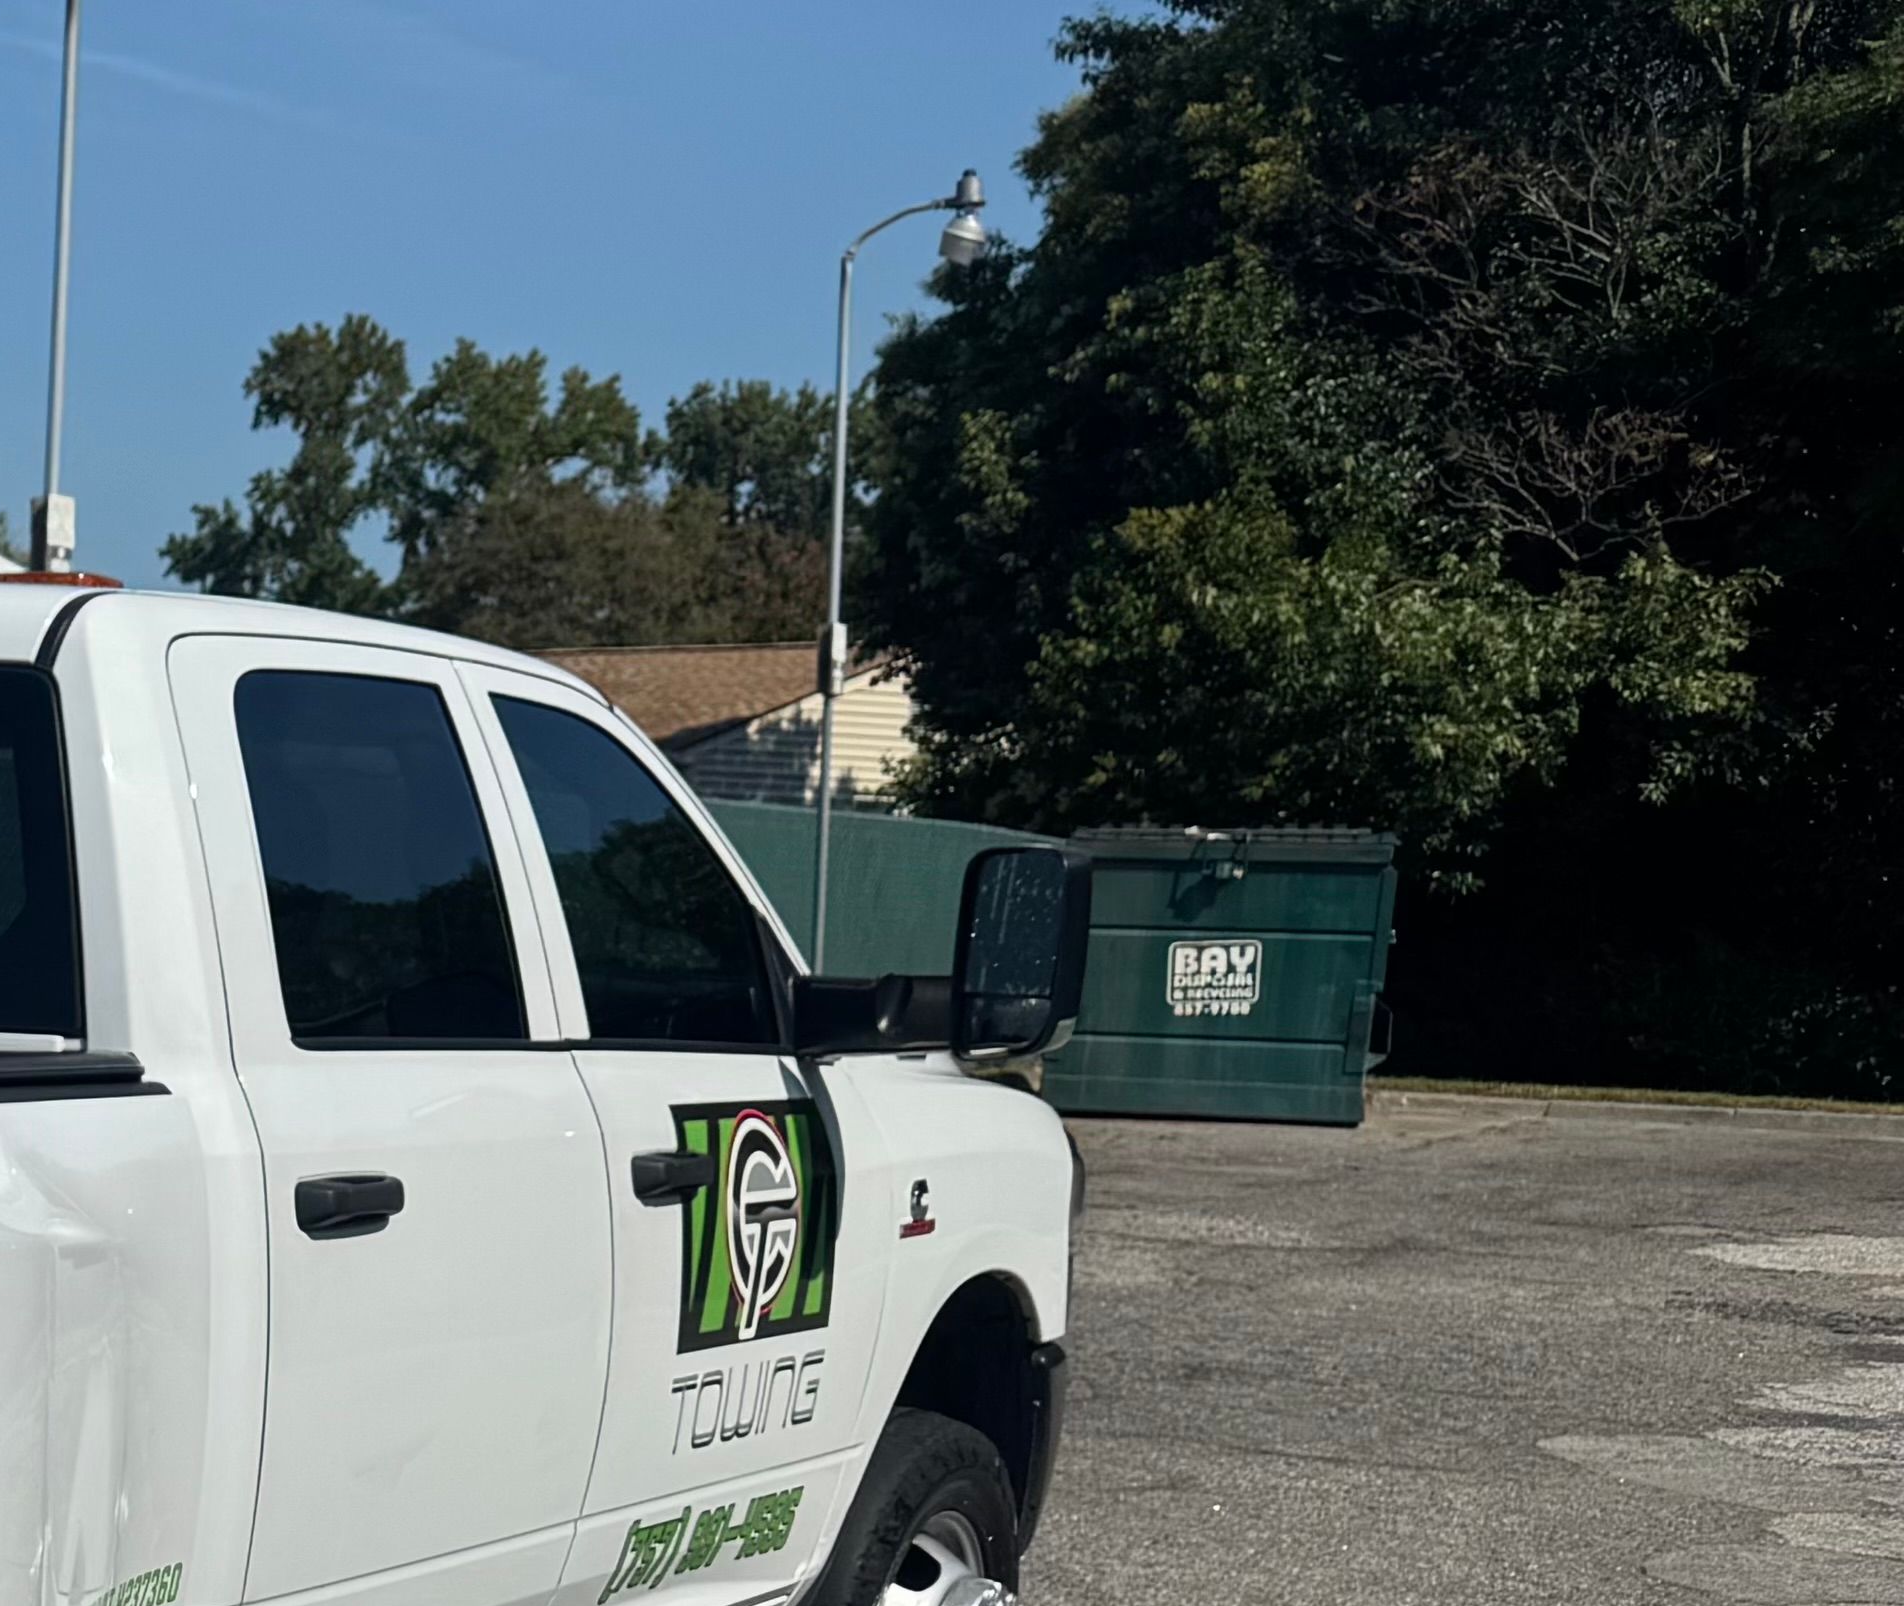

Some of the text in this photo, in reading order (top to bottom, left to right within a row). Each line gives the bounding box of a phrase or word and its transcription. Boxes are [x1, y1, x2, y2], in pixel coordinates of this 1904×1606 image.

[1174, 945, 1256, 975] BAY
[671, 1348, 826, 1455] TOWING
[674, 1485, 805, 1575] 981-4595
